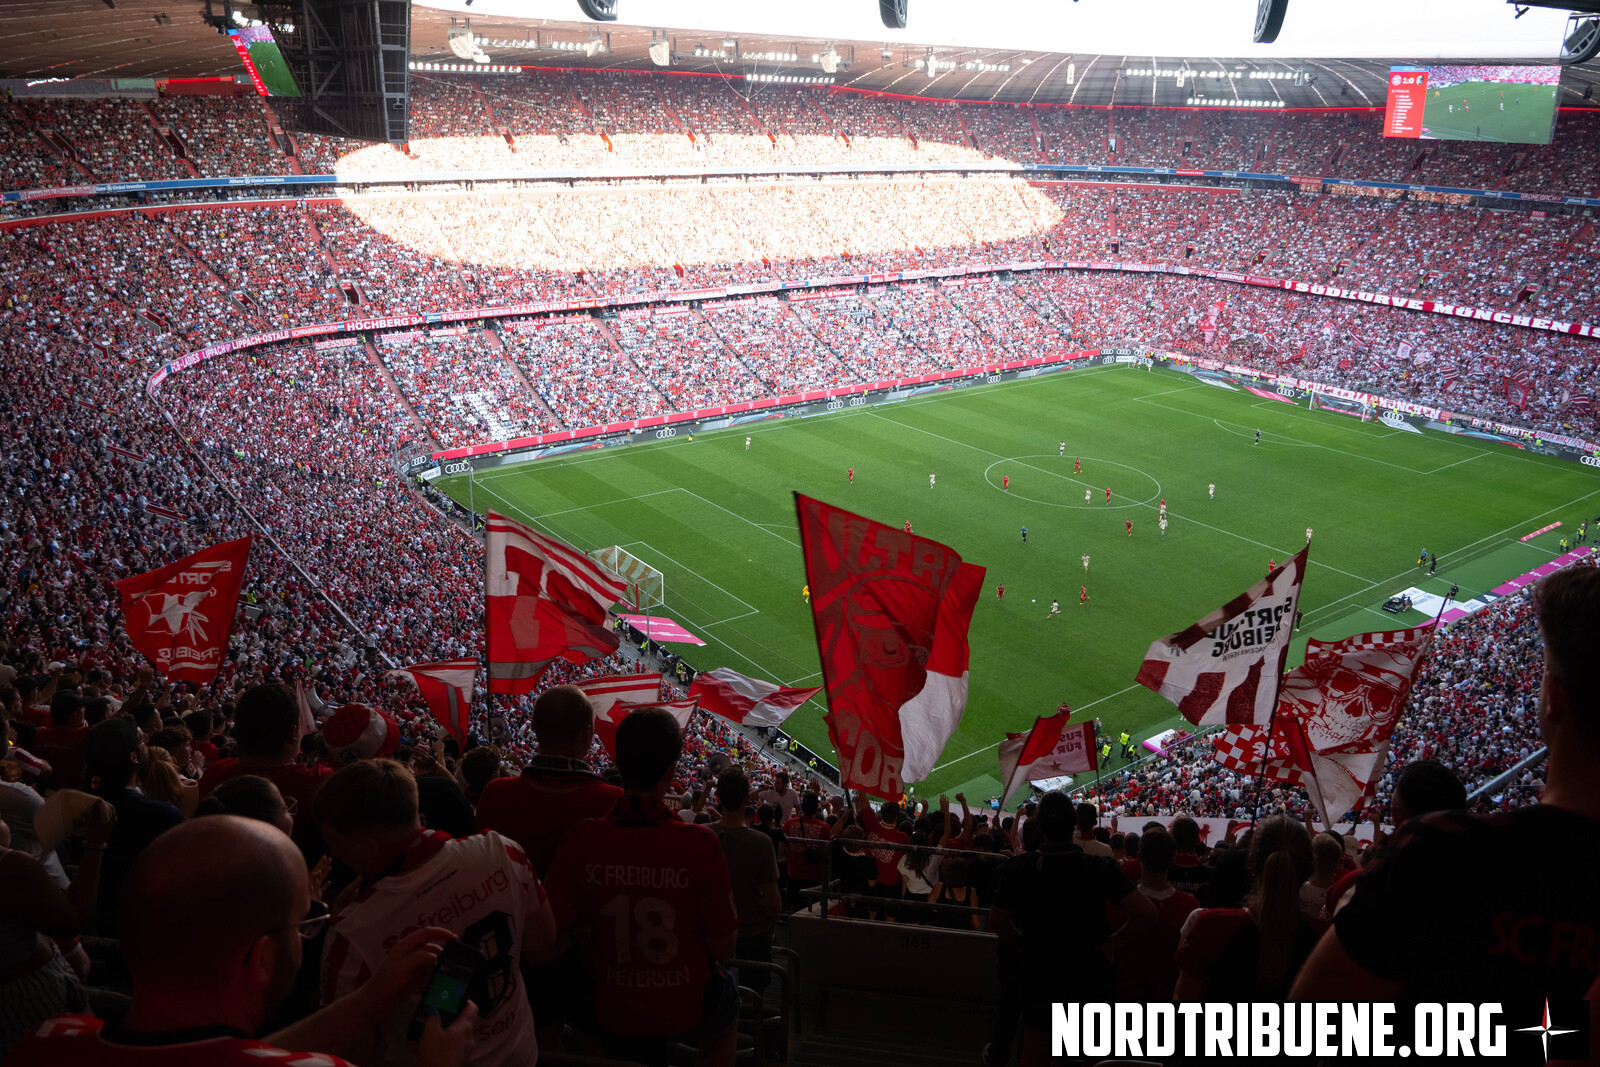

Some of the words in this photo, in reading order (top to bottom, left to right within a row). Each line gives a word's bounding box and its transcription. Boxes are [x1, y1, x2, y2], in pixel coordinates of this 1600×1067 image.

[1295, 283, 1424, 310] SÜDKURVE
[1432, 303, 1572, 333] MÜNCHEN
[202, 344, 225, 359] LIPPACH
[232, 330, 290, 349] LIPPACH-OSTALB
[1299, 380, 1368, 404] SCHICKERIA
[585, 863, 602, 884] SC
[605, 864, 690, 888] FREIBURG
[600, 894, 680, 965] 18
[1487, 911, 1543, 967] SC
[606, 966, 690, 987] PETERSEN
